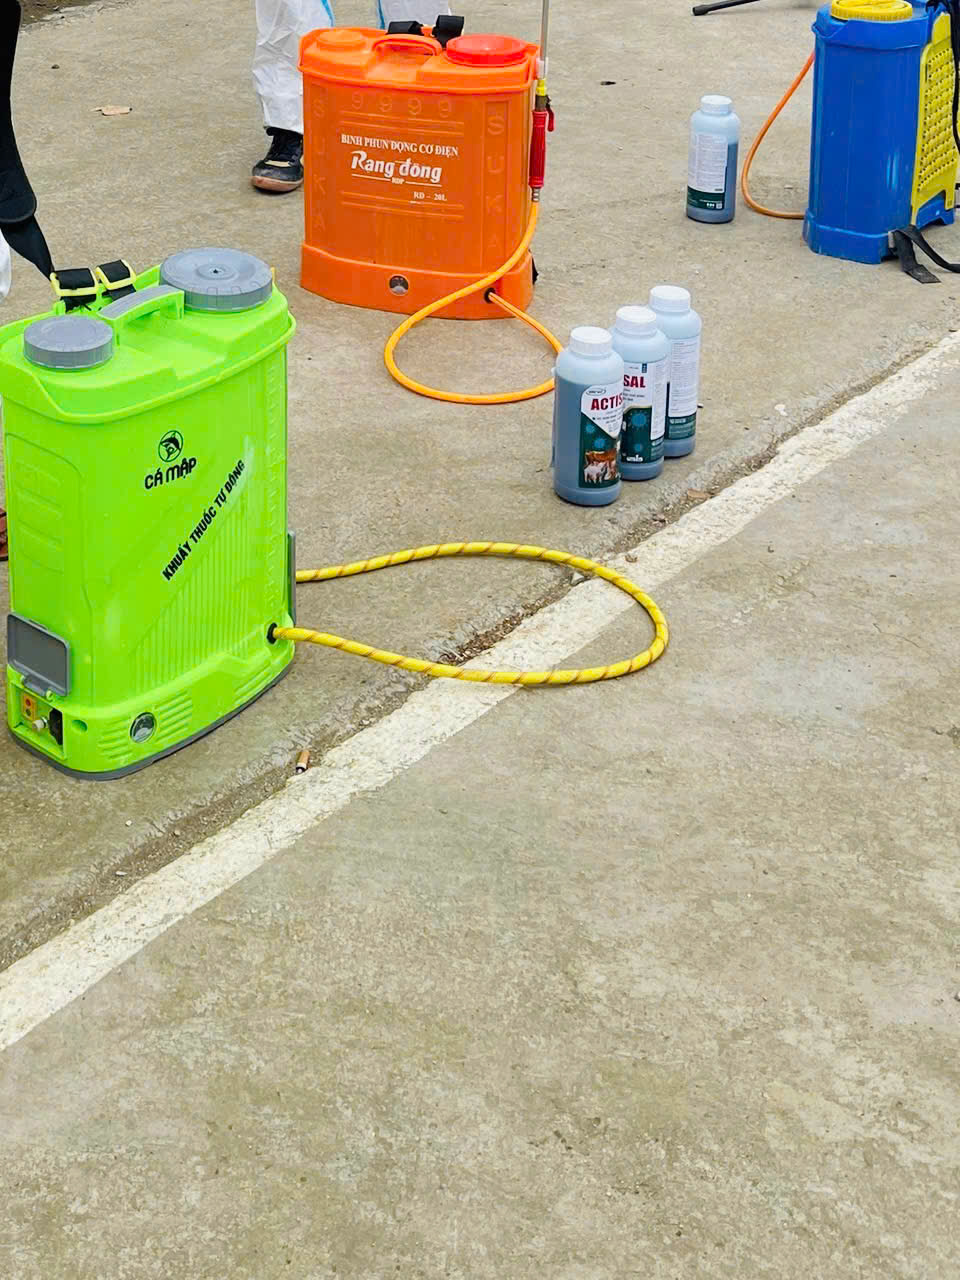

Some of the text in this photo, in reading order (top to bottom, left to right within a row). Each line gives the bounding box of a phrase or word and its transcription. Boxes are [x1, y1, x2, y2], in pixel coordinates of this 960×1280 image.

[364, 137, 389, 150] PHUN
[623, 374, 646, 388] SAL
[591, 392, 623, 410] ACTIS
[144, 457, 197, 490] CÁ MẬP
